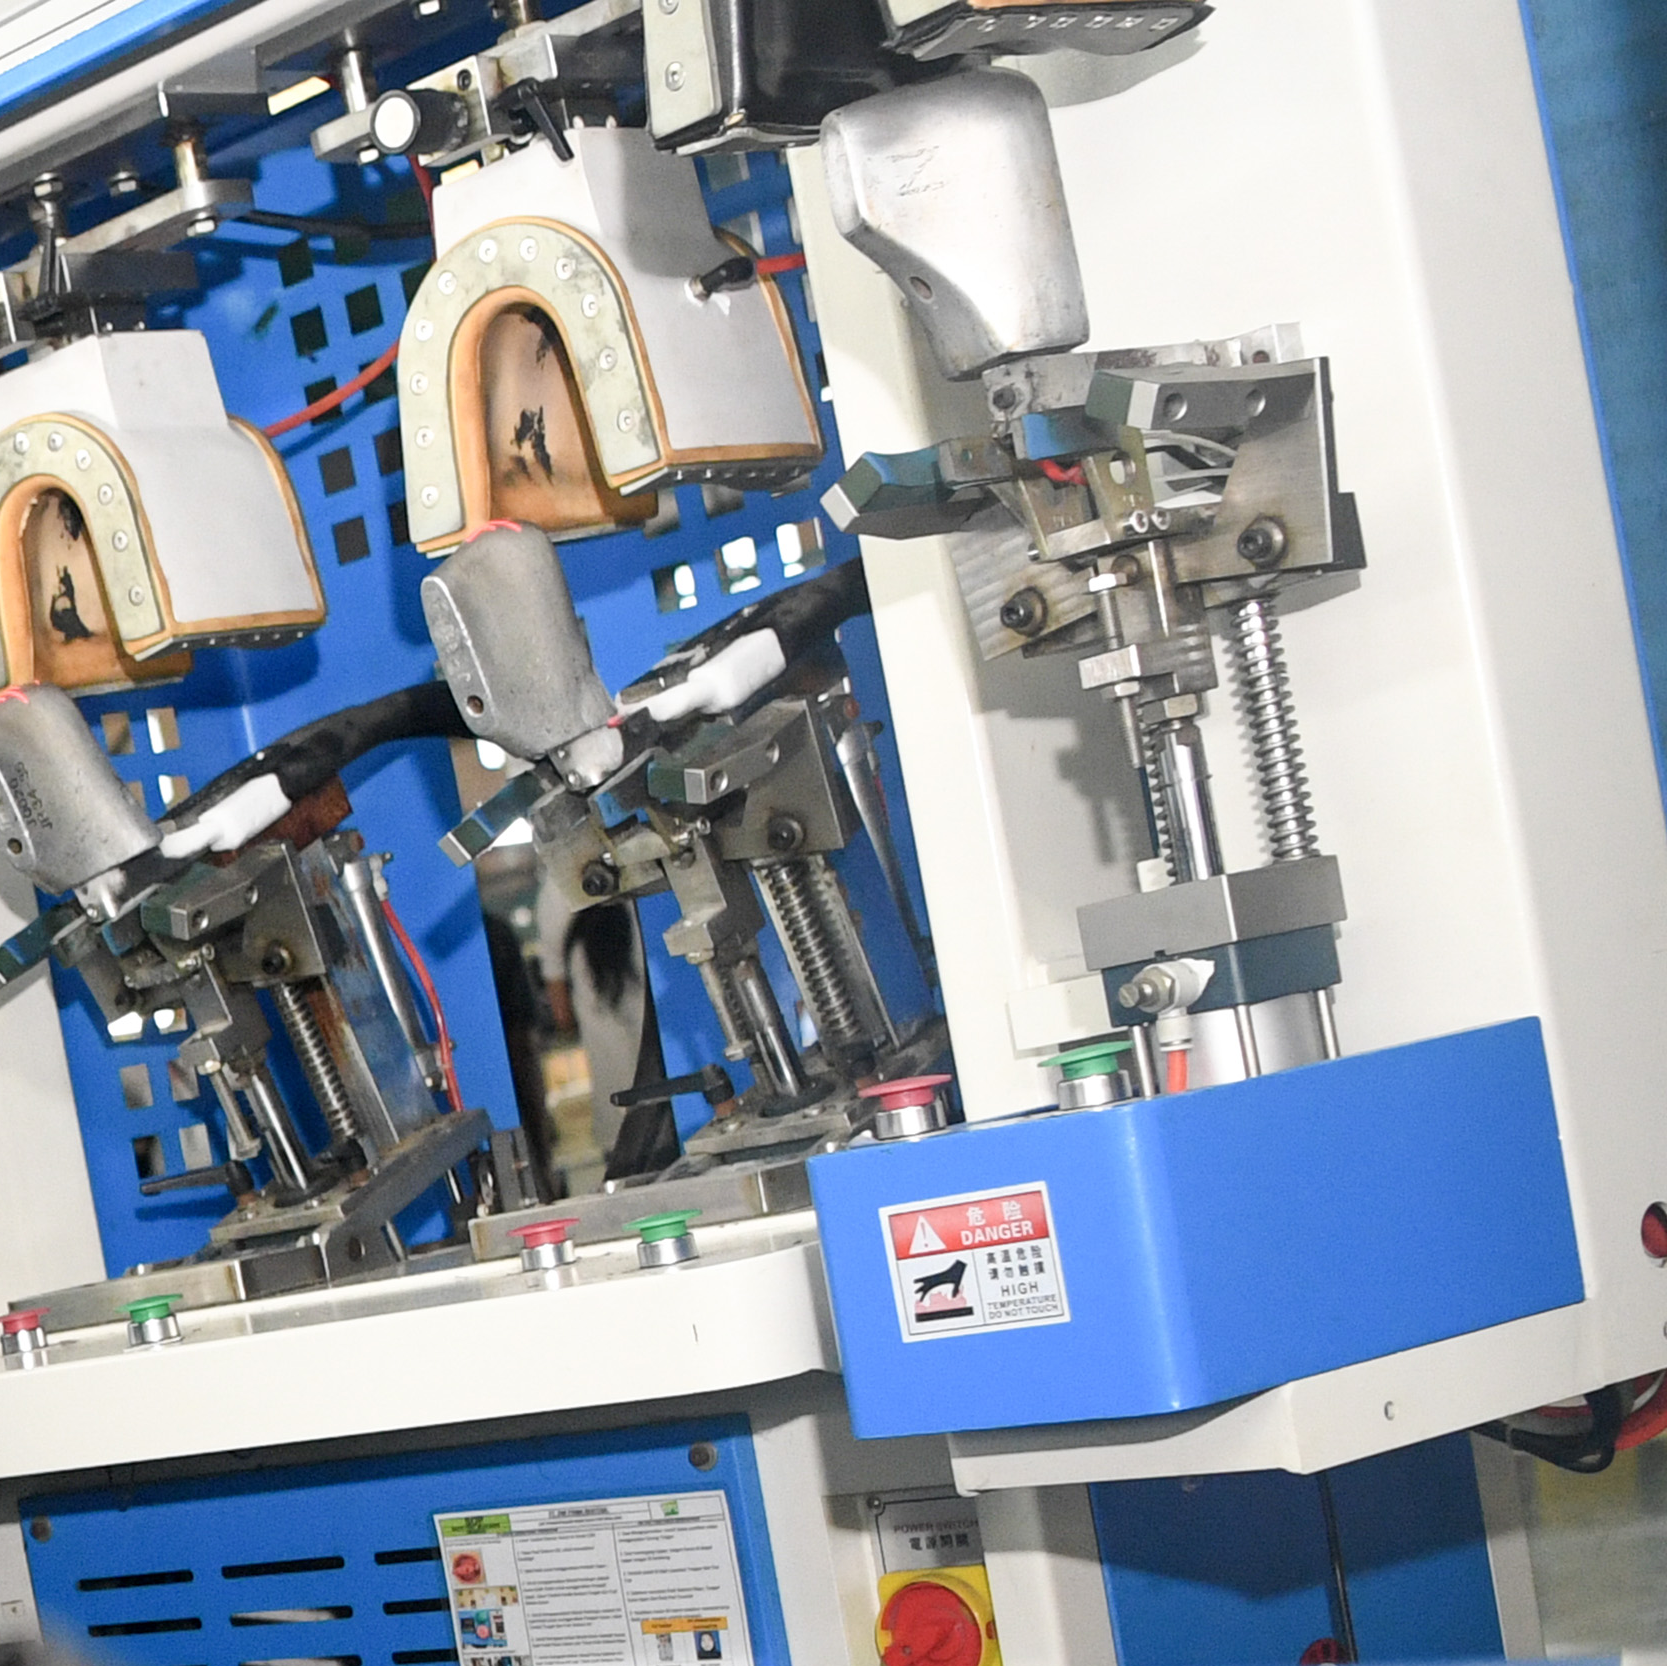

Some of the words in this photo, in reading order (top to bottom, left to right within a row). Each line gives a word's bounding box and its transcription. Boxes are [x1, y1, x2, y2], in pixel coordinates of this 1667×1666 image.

[960, 1220, 1034, 1246] DANGER
[1001, 1282, 1038, 1297] HIGH
[987, 1295, 1057, 1310] TEMPERATURE
[893, 1522, 934, 1534] POWER
